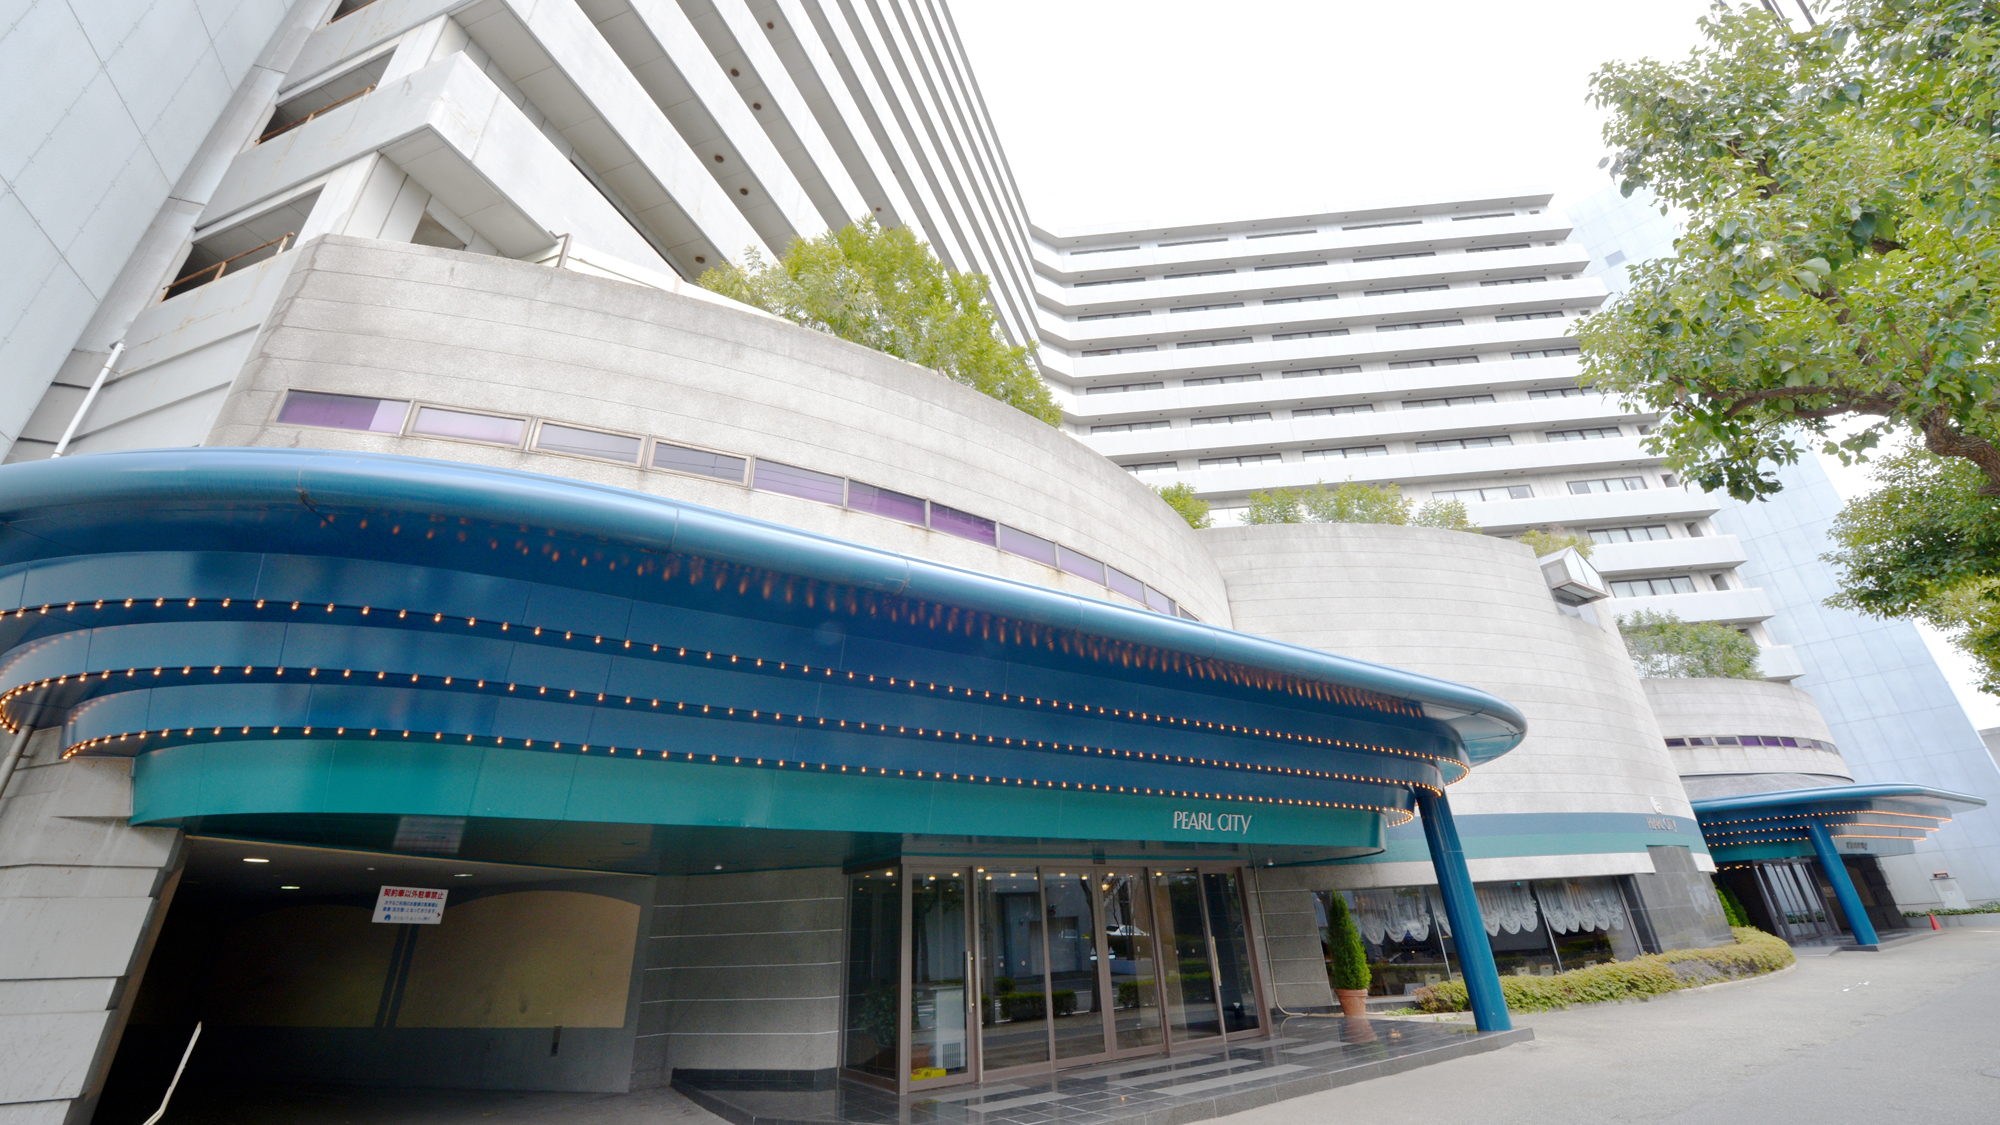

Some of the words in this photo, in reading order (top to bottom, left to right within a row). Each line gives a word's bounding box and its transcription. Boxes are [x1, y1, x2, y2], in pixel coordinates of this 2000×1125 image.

[1173, 811, 1215, 830] PEARL
[1217, 813, 1252, 835] CITY
[383, 888, 444, 900] 契約車以外駐車禁止
